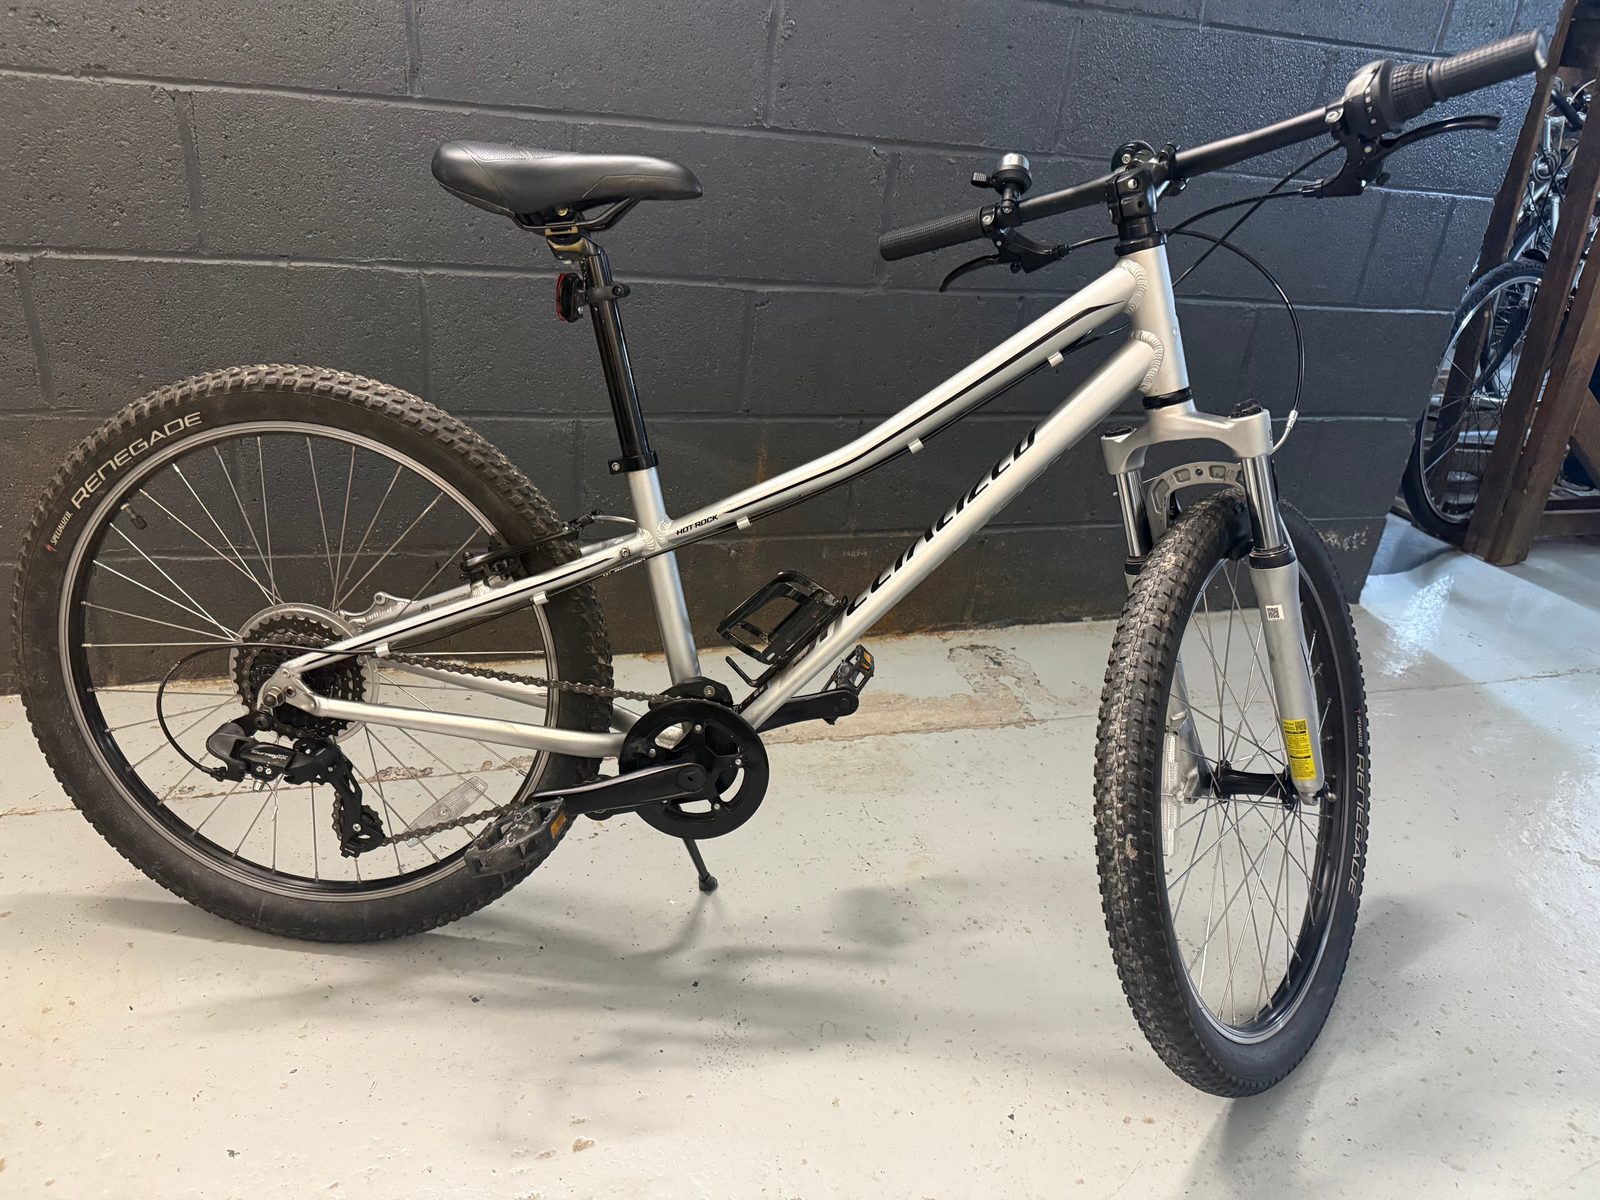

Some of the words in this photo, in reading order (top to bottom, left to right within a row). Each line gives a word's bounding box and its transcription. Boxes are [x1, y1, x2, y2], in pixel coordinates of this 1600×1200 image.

[71, 411, 203, 510] RENEGADE
[676, 524, 694, 536] HOT
[694, 514, 719, 528] ROCK
[1347, 752, 1365, 898] RENEGADE
